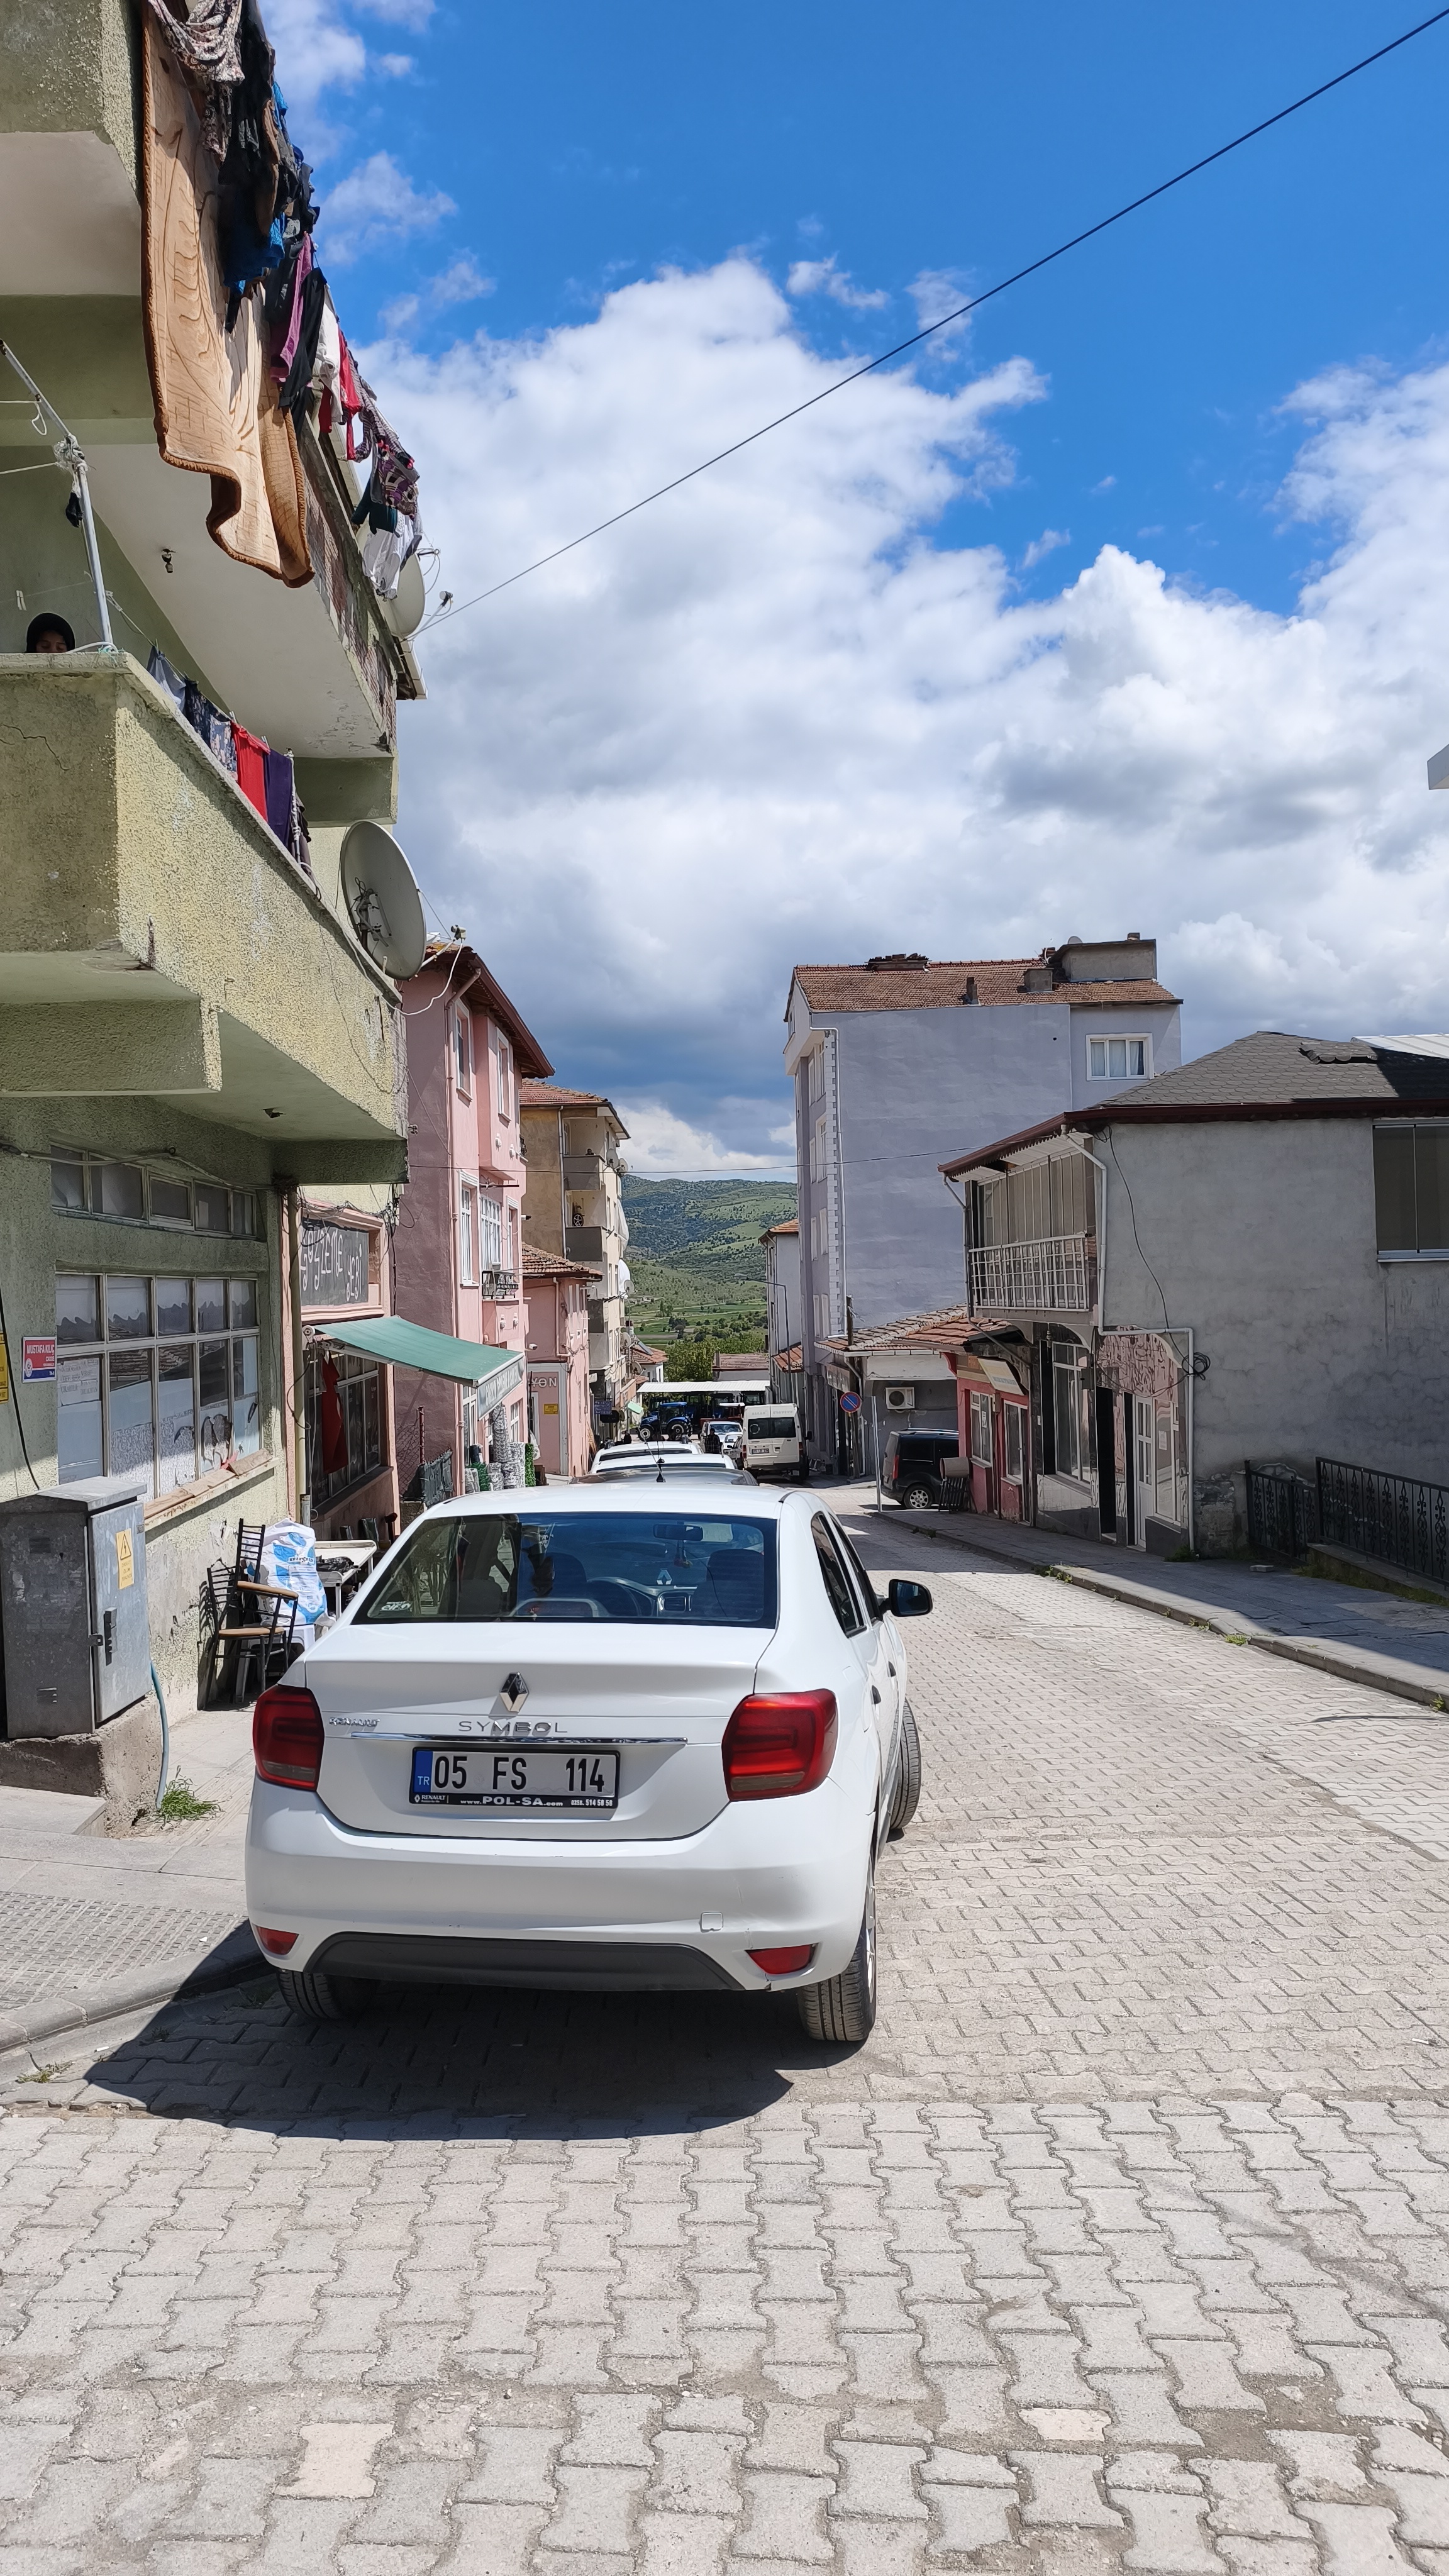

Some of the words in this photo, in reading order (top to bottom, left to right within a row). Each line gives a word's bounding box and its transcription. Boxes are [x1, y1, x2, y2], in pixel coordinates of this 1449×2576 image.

[26, 1345, 45, 1354] MUSTAFA
[45, 1344, 55, 1356] KILIÇ
[329, 1718, 380, 1728] RENAULT
[458, 1721, 568, 1733] SYMBOL
[434, 1756, 468, 1789] 05
[492, 1757, 527, 1790] FS
[565, 1758, 604, 1792] 114
[418, 1776, 430, 1785] TR
[460, 1796, 563, 1806] www.POL-SA.com
